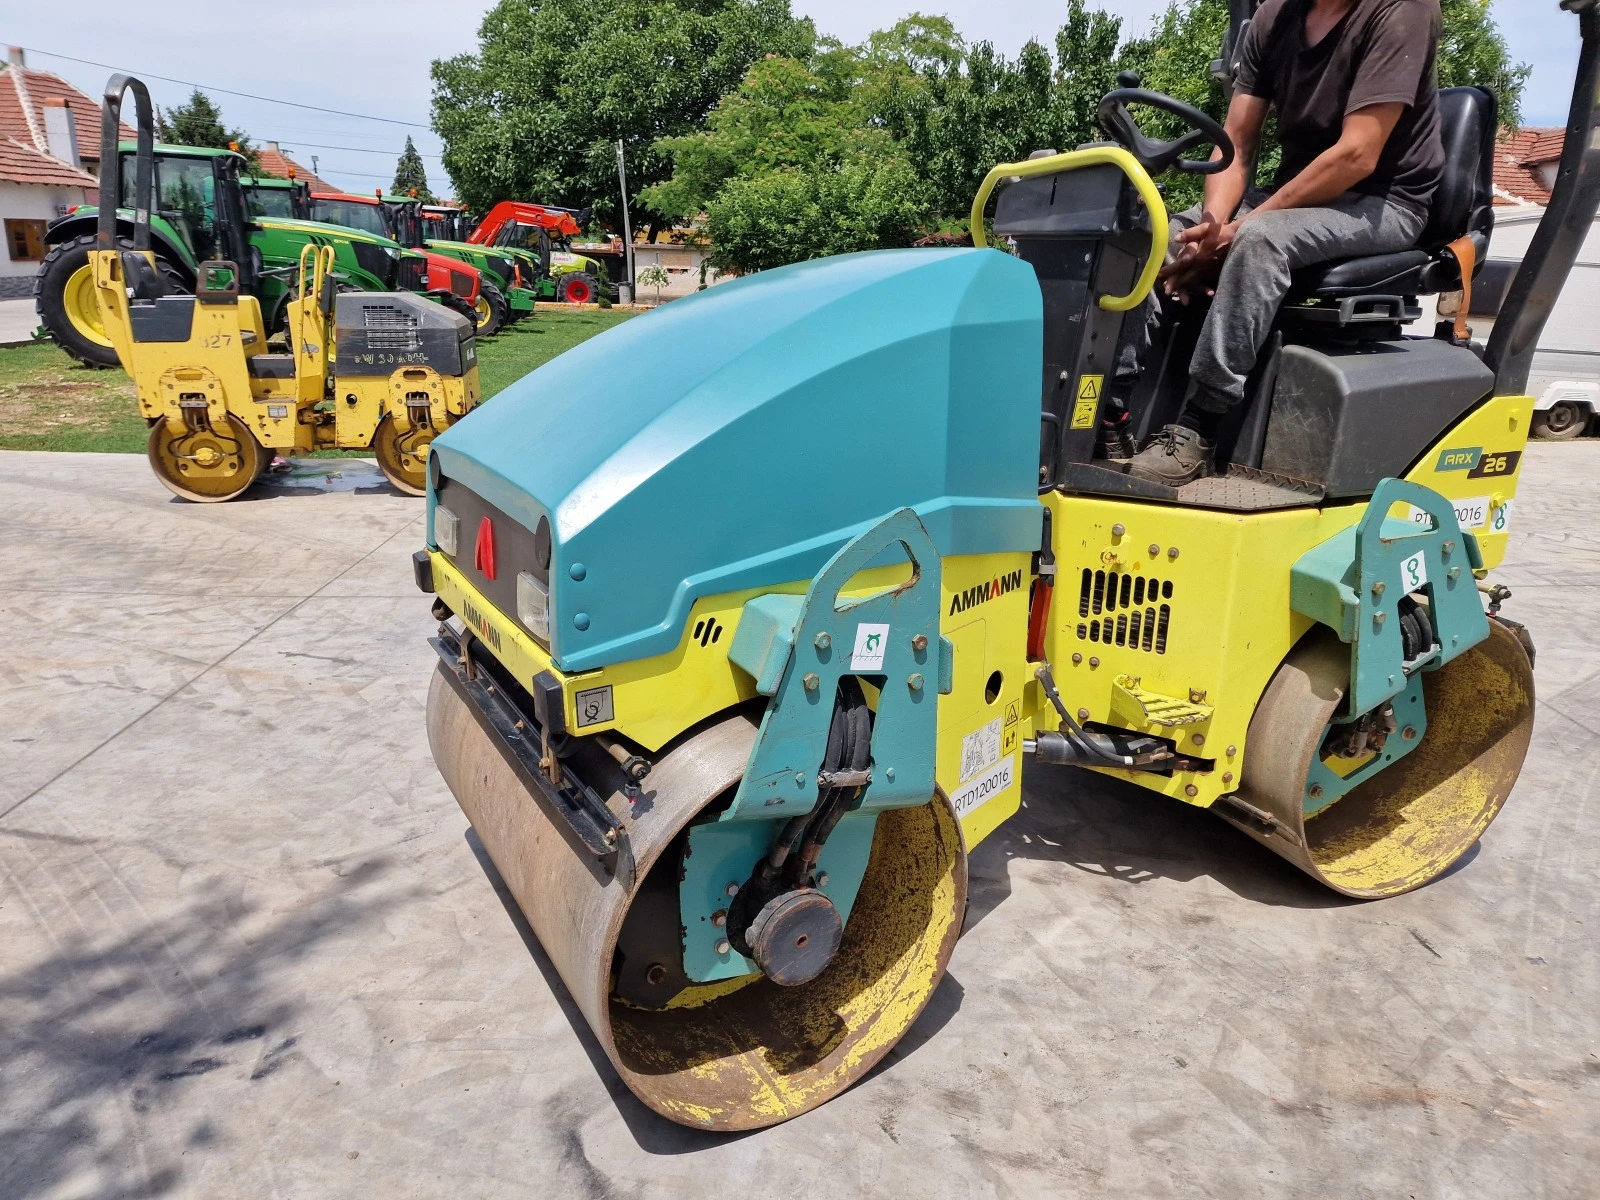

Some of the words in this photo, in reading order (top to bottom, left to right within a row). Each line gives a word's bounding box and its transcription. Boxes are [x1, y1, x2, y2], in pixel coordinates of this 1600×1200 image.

[1444, 452, 1474, 466] ARX
[1483, 456, 1507, 474] 26
[949, 568, 1022, 617] AMMANN
[463, 599, 502, 654] AMMANN
[954, 767, 1009, 812] RTD120016
